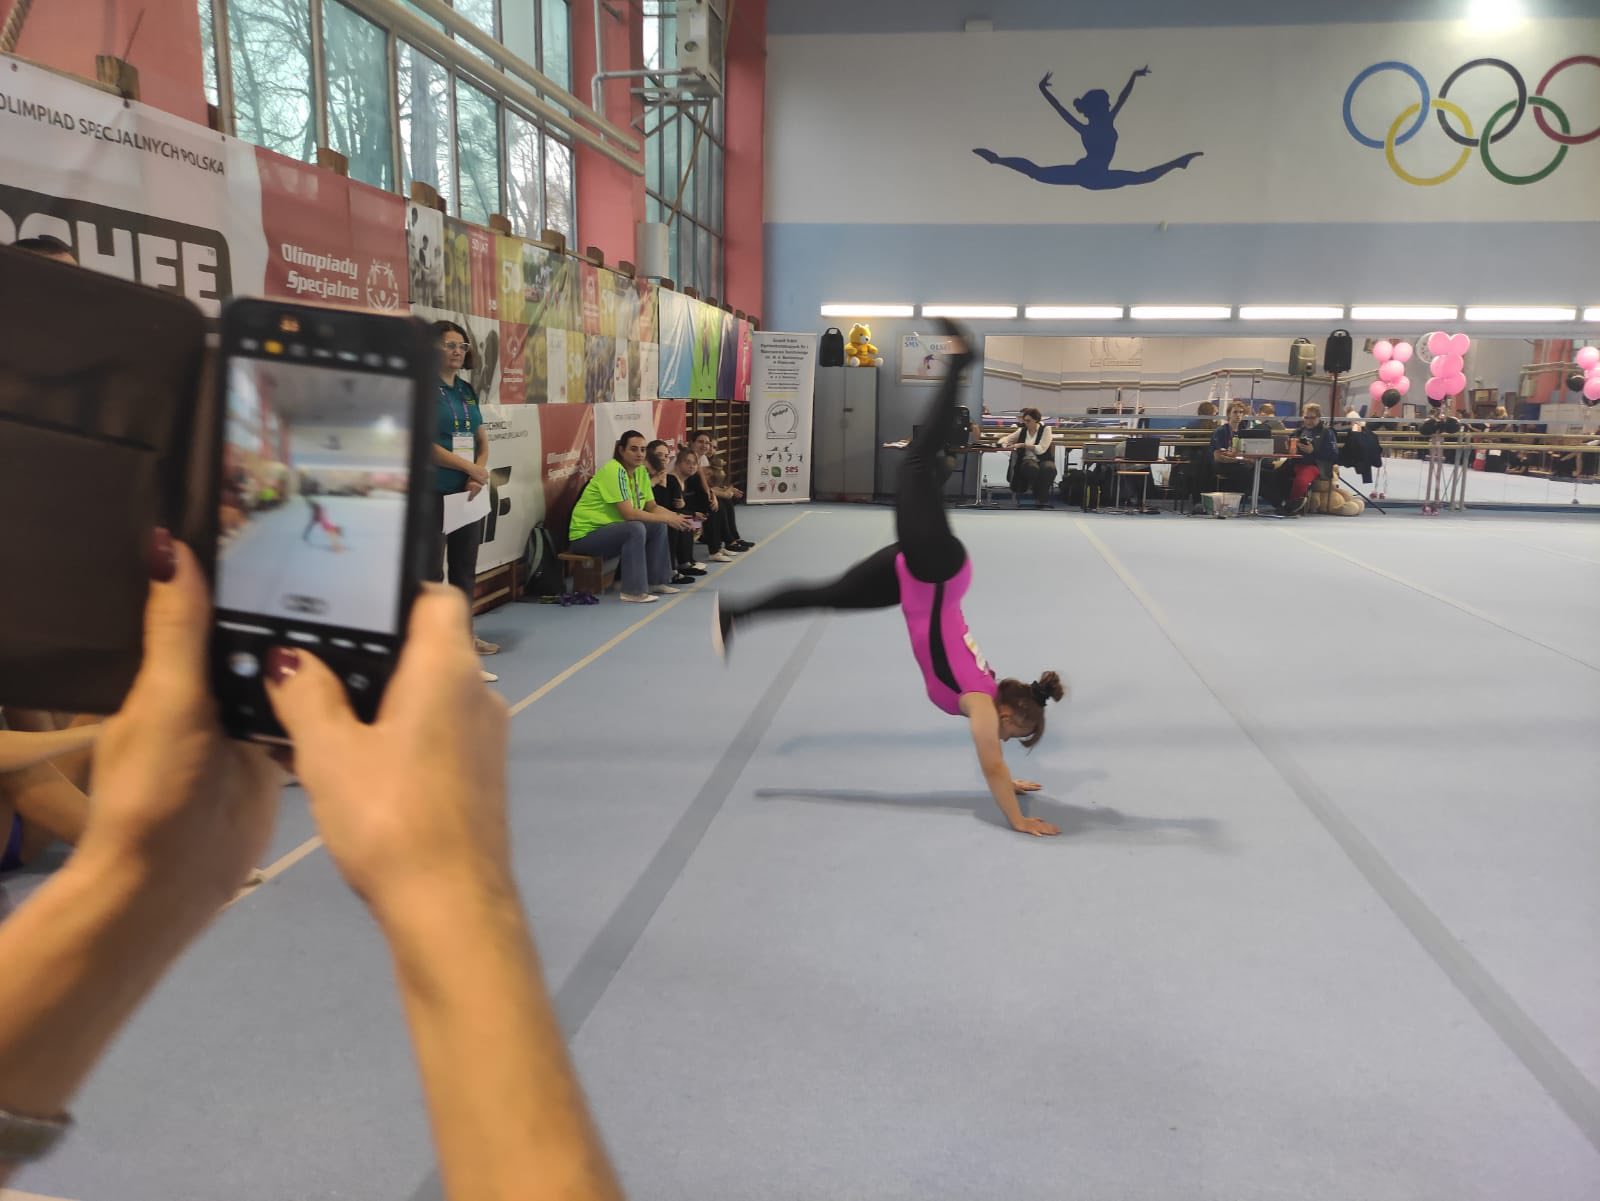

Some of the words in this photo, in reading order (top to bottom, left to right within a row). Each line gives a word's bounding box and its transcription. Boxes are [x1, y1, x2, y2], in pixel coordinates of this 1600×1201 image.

[80, 118, 180, 161] SPECJALNYCH
[182, 148, 225, 175] POLSKA
[281, 243, 358, 280] Olimpiady
[286, 270, 359, 300] Specjalne
